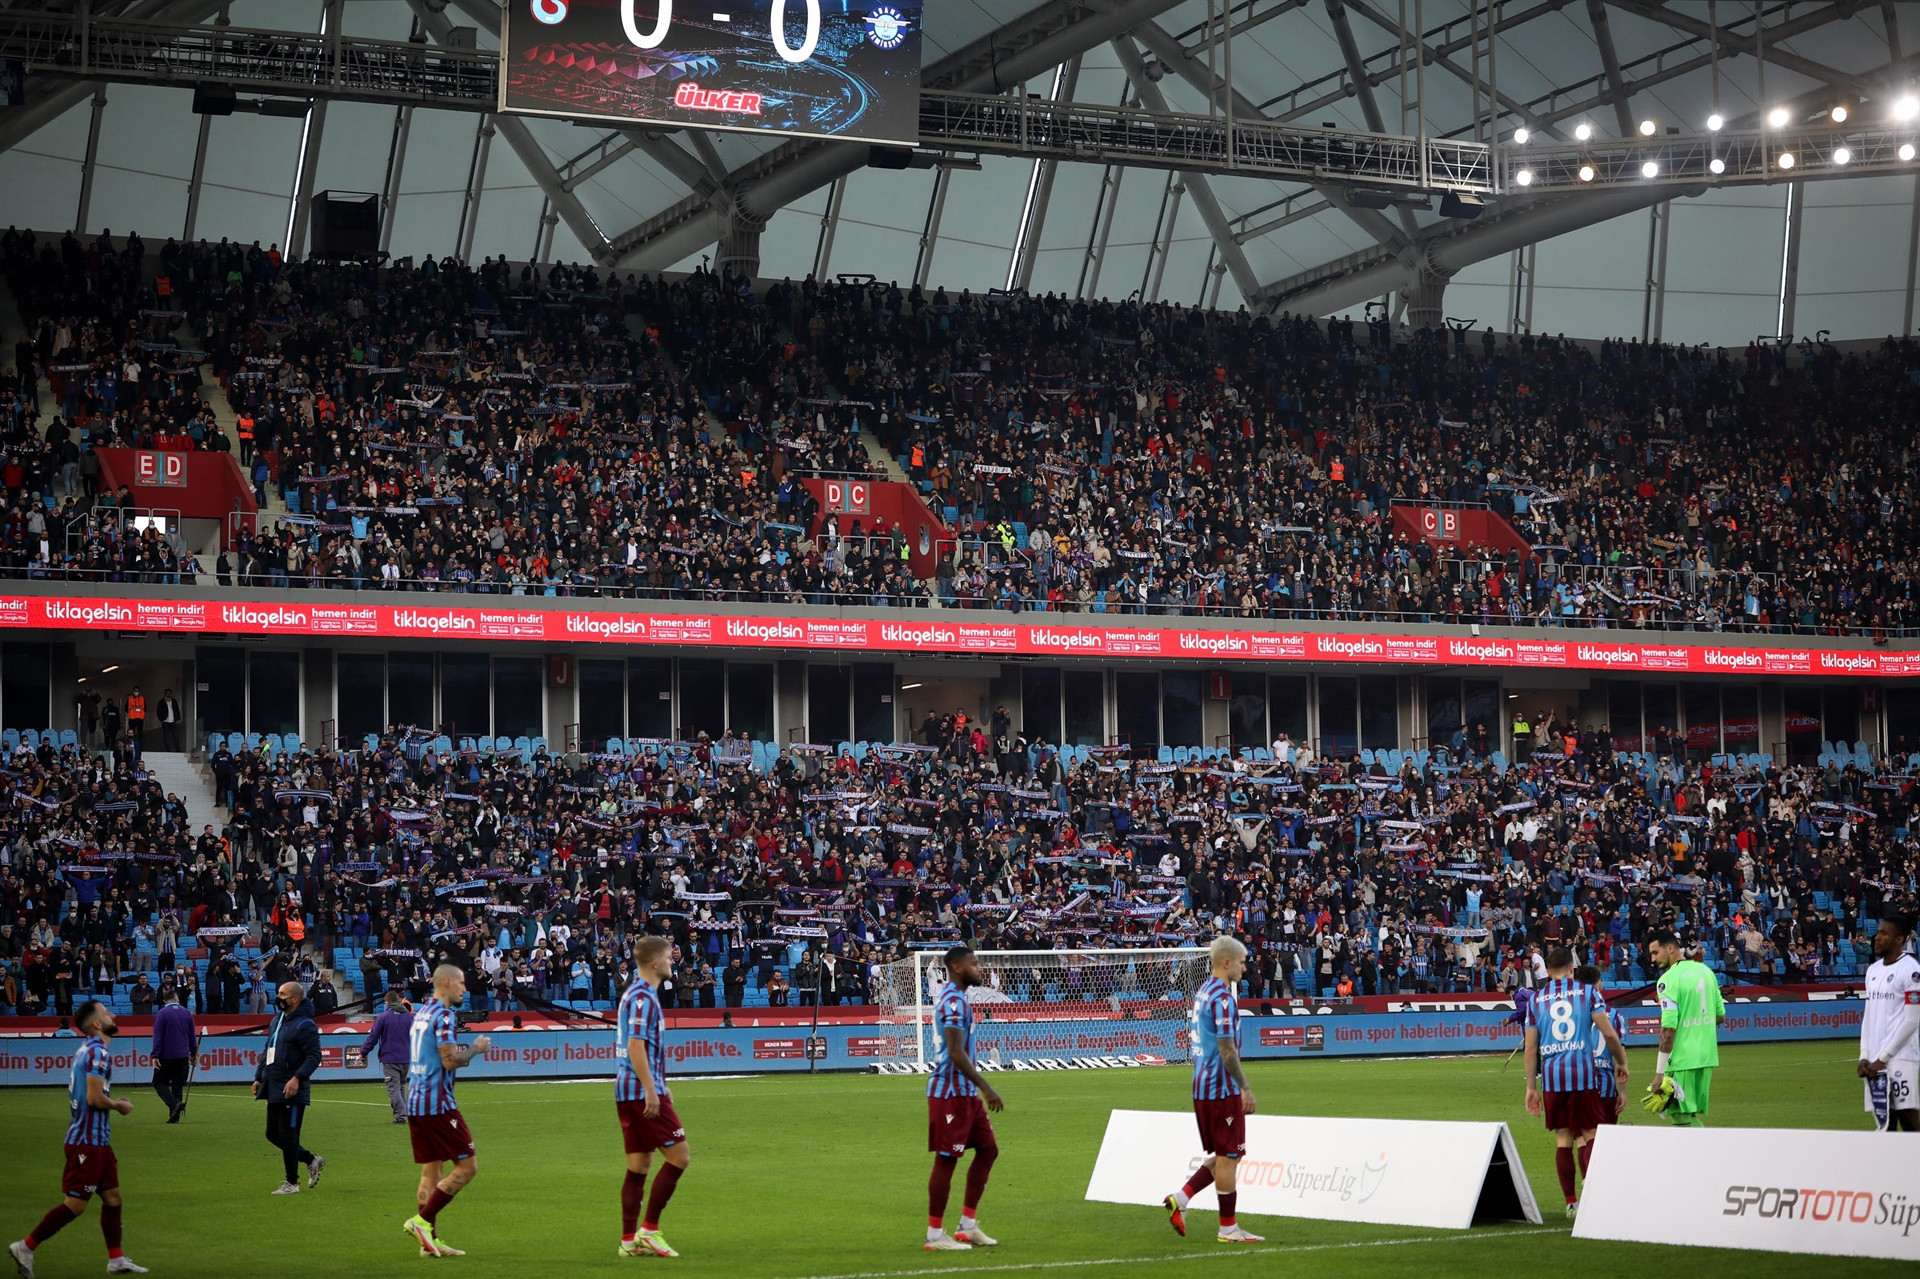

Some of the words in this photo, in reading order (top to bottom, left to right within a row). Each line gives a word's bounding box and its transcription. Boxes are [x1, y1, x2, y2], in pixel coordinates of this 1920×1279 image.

[872, 6, 901, 20] ADANA
[621, 0, 673, 49] 0
[770, 0, 821, 63] 0
[675, 82, 761, 115] ÜLKER
[140, 455, 153, 475] E
[167, 456, 181, 476] D
[829, 484, 841, 503] D
[852, 485, 864, 504] C
[1424, 512, 1436, 530] C
[1444, 513, 1456, 530] B
[47, 602, 131, 623] tiklagelsin
[138, 603, 173, 613] hemen
[178, 605, 204, 614] indir!
[223, 606, 306, 628] tiklagelsin
[312, 608, 346, 617] hemen
[350, 609, 376, 618] indir!
[395, 611, 474, 632] tiklagelsin
[481, 613, 514, 623] hemen
[518, 614, 543, 624] indir!
[567, 616, 645, 637] tiklagelsin
[650, 617, 682, 627] hemen
[686, 619, 710, 628] indir!
[808, 622, 838, 631] hemen
[842, 623, 866, 633] indir!
[728, 620, 802, 641] tiklagelsin
[882, 625, 954, 645] tiklagelsin
[960, 627, 990, 636] hemen
[993, 628, 1015, 637] indir!
[1031, 629, 1101, 649] tiklagelsin
[1106, 631, 1134, 640] hemen
[1138, 632, 1159, 641] indir!
[1252, 635, 1278, 644] hemen
[1282, 636, 1303, 645] indir!
[1181, 634, 1247, 653] tiklagelsin
[1318, 637, 1382, 656] tiklagelsin
[1387, 639, 1413, 648] hemen
[1416, 640, 1436, 649] indir!
[1451, 641, 1513, 660] tiklagelsin
[1517, 643, 1542, 652] hemen
[1546, 644, 1565, 652] indir!
[1642, 648, 1666, 656] hemen
[1669, 649, 1687, 657] indir!
[1578, 646, 1637, 664] tiklagelsin
[1705, 651, 1761, 668] tiklagelsin
[1766, 652, 1789, 660] hemen
[1822, 654, 1876, 670] tiklagelsin
[556, 661, 567, 684] J
[1696, 976, 1707, 1014] 1
[1549, 1000, 1576, 1041] 8
[1754, 1012, 1807, 1028] haberleri
[1811, 1010, 1864, 1028] Dergilik'
[1335, 1027, 1363, 1041] tüm
[1367, 1027, 1396, 1043] spor
[1401, 1022, 1461, 1039] haberleri
[1465, 1021, 1521, 1040] Dergilik
[523, 1047, 559, 1065] spor
[564, 1042, 617, 1060] haberl
[666, 1040, 743, 1062] rgilik'te.
[1539, 1040, 1585, 1056] DORUKHAN
[0, 1053, 28, 1069] üm
[34, 1056, 73, 1073] spor
[1011, 1055, 1140, 1071] AIRLINES
[1892, 1080, 1909, 1098] 95
[1282, 1162, 1357, 1202] SüperLig
[1723, 1185, 1873, 1223] SPORTOTO
[1874, 1192, 1920, 1237] Süp
